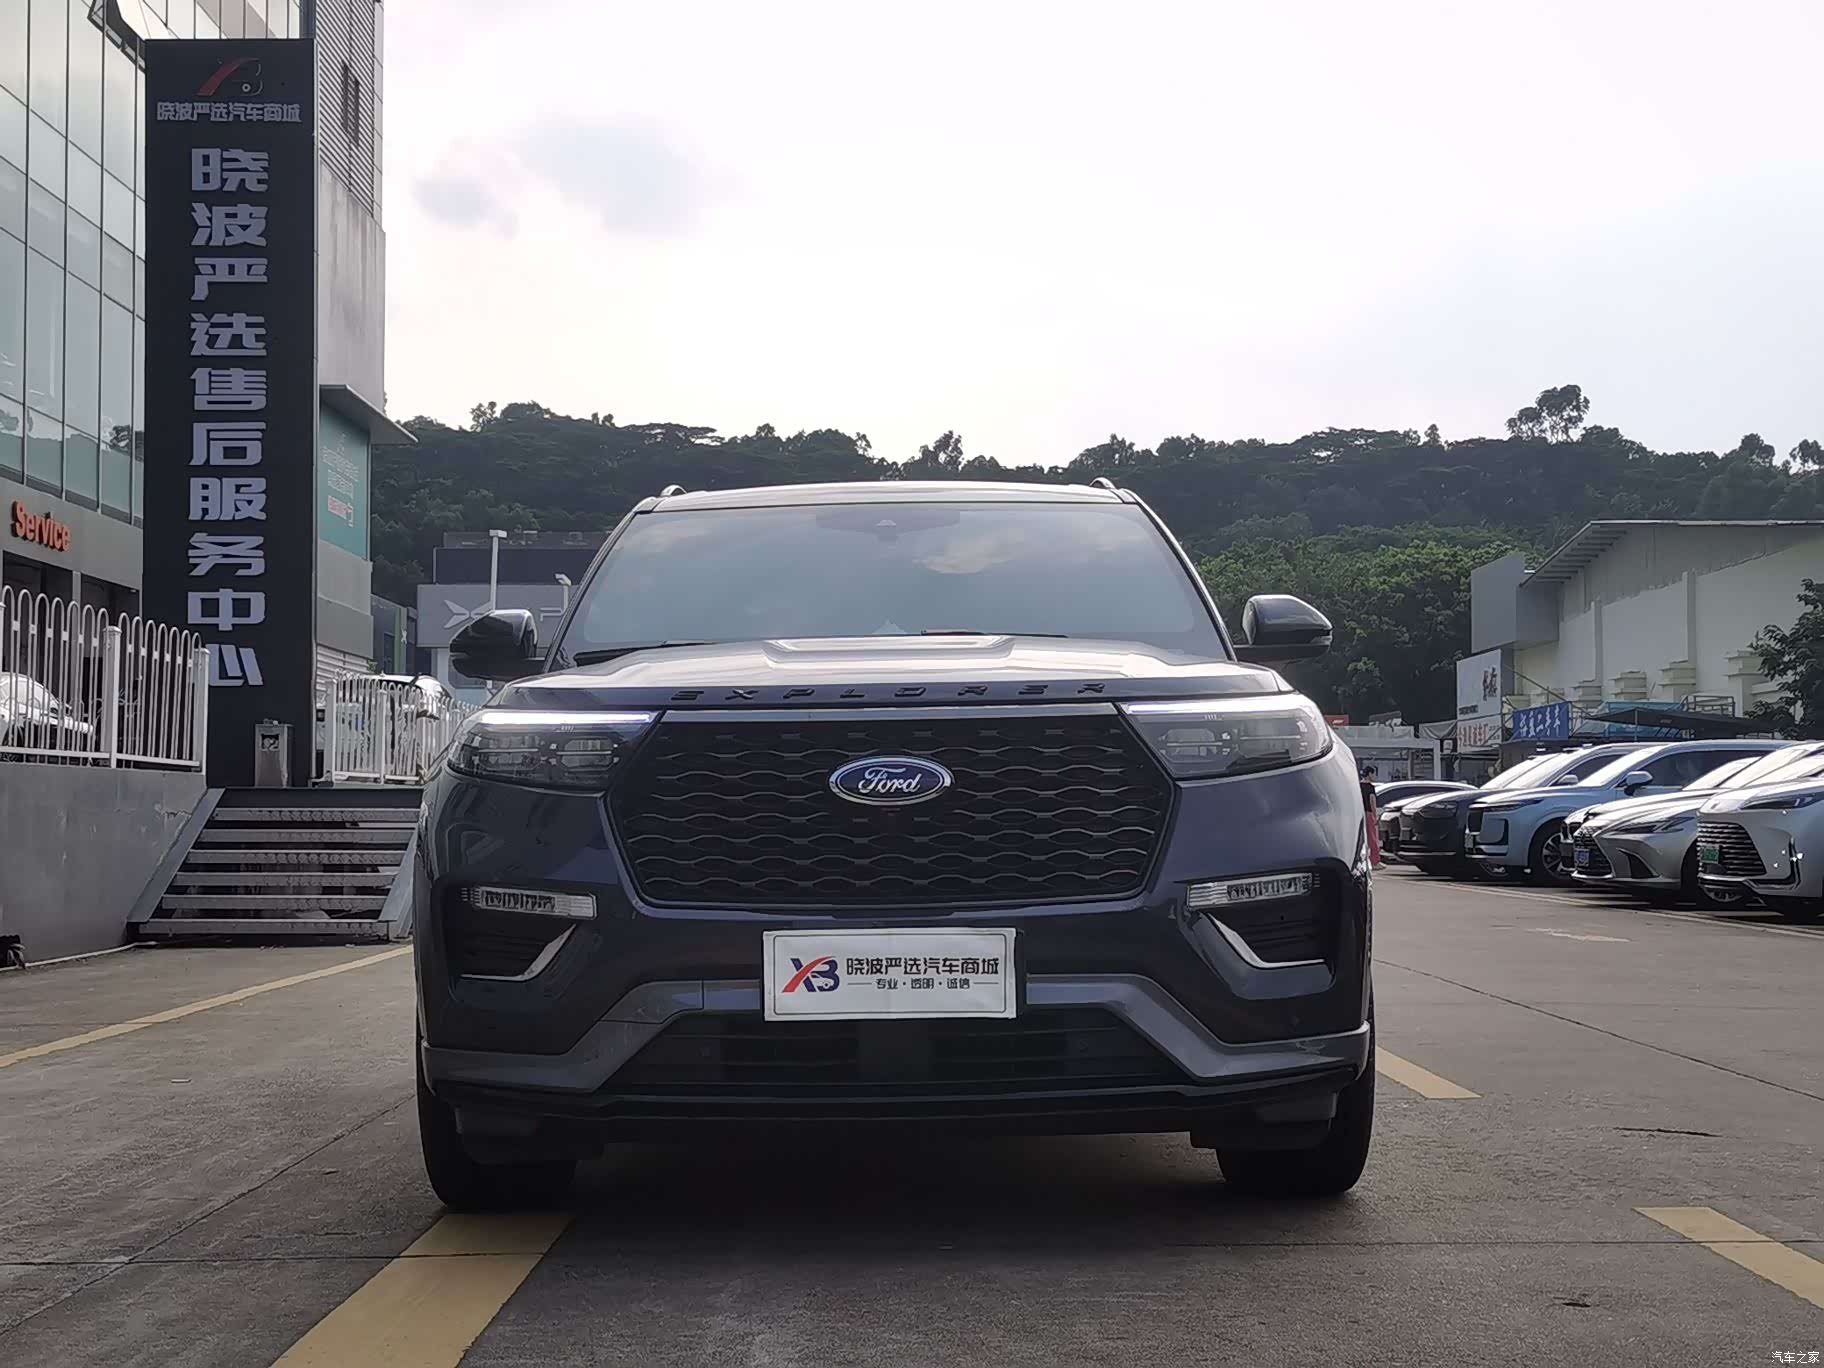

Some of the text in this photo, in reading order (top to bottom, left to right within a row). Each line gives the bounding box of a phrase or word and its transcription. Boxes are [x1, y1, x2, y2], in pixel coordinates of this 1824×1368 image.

[156, 101, 302, 122] 晓波严选汽车商城
[187, 147, 269, 688] 晓波严选售后服务中心
[14, 498, 71, 552] Service
[671, 682, 1106, 701] EXPLORER
[858, 766, 923, 794] Ford
[845, 957, 1000, 976] 晓波严选汽车商城
